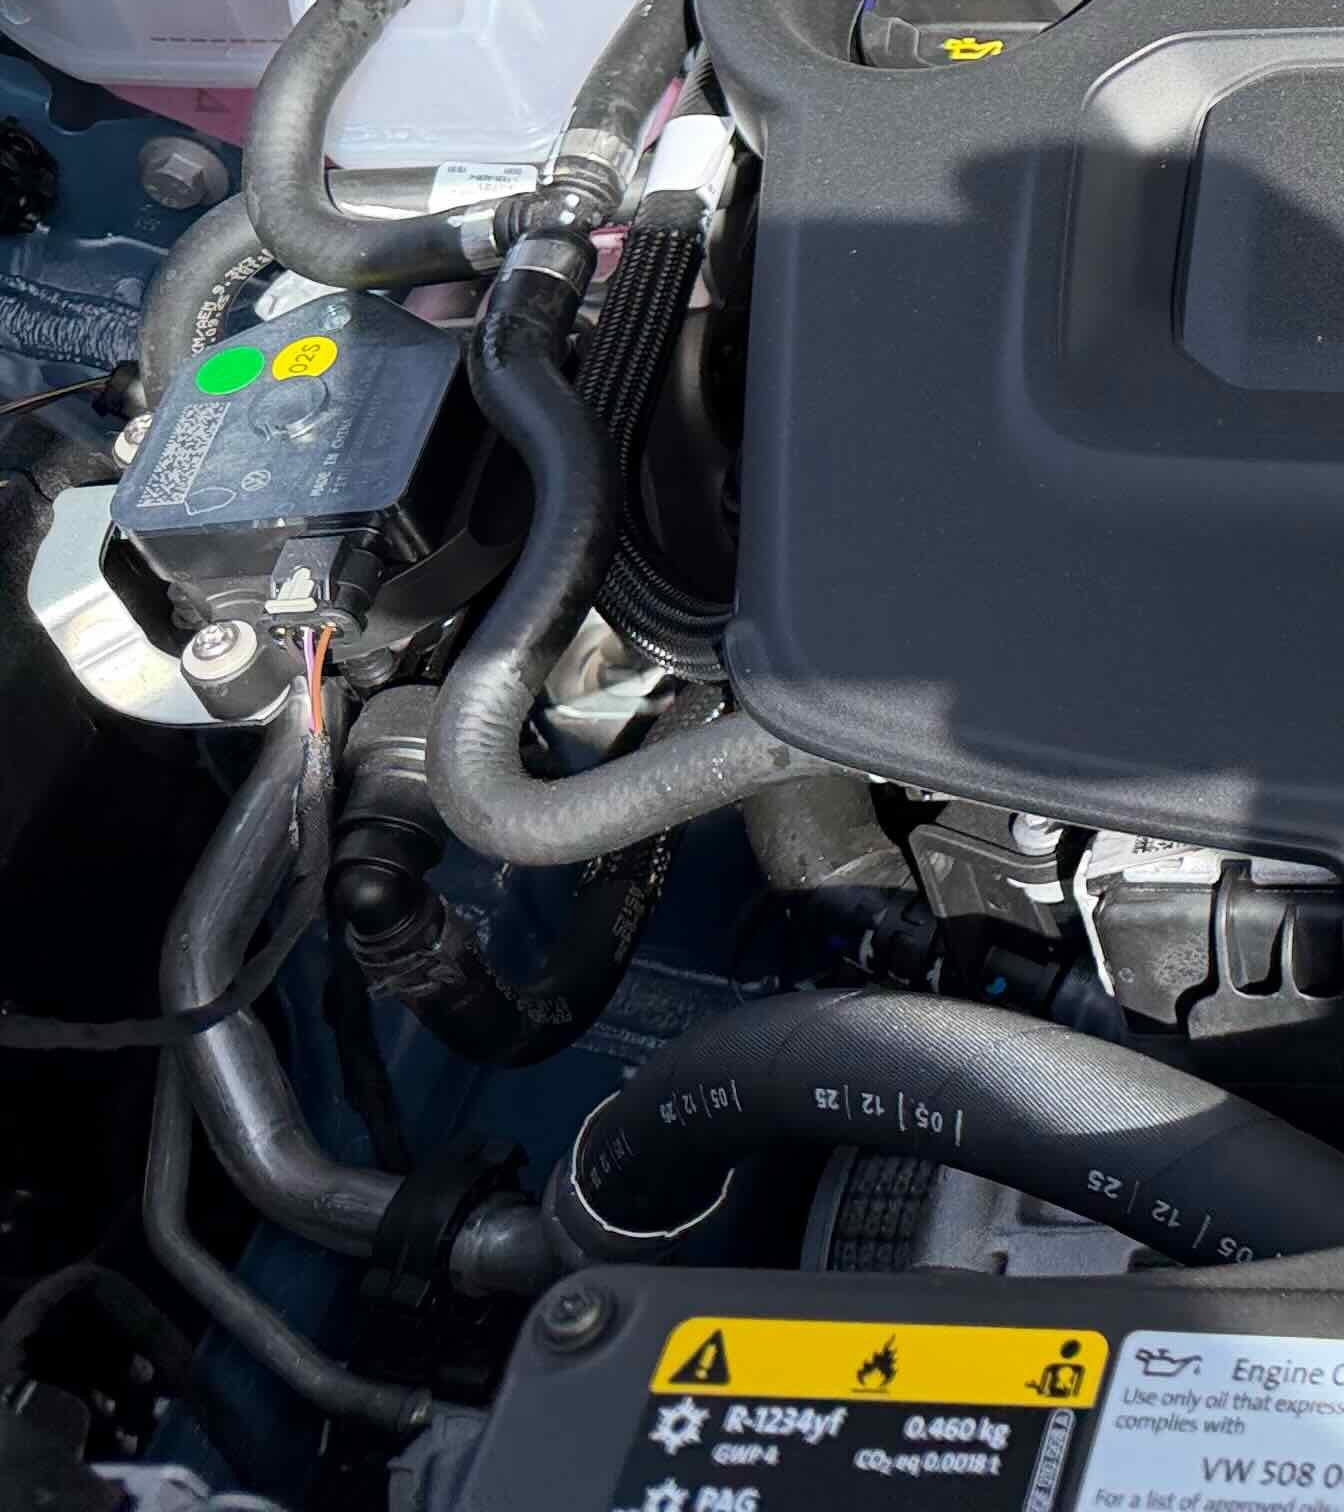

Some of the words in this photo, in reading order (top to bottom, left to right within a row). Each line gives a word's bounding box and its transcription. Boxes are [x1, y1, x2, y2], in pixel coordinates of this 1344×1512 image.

[814, 1087, 840, 1111] 25
[860, 1092, 886, 1117] 12
[1087, 1168, 1123, 1199] 25
[1151, 1199, 1182, 1228] 12
[1231, 1357, 1325, 1390] Engine
[1122, 1387, 1158, 1407] Use
[1160, 1389, 1202, 1414] only
[1205, 1392, 1229, 1410] oil
[1232, 1392, 1272, 1412] that
[721, 1403, 849, 1446] R-1234yf
[903, 1414, 977, 1442] 0.460
[1114, 1413, 1199, 1435] complies
[1203, 1416, 1246, 1436] with
[1200, 1456, 1255, 1484] VW
[1259, 1459, 1316, 1488] 508
[1095, 1487, 1124, 1509] For
